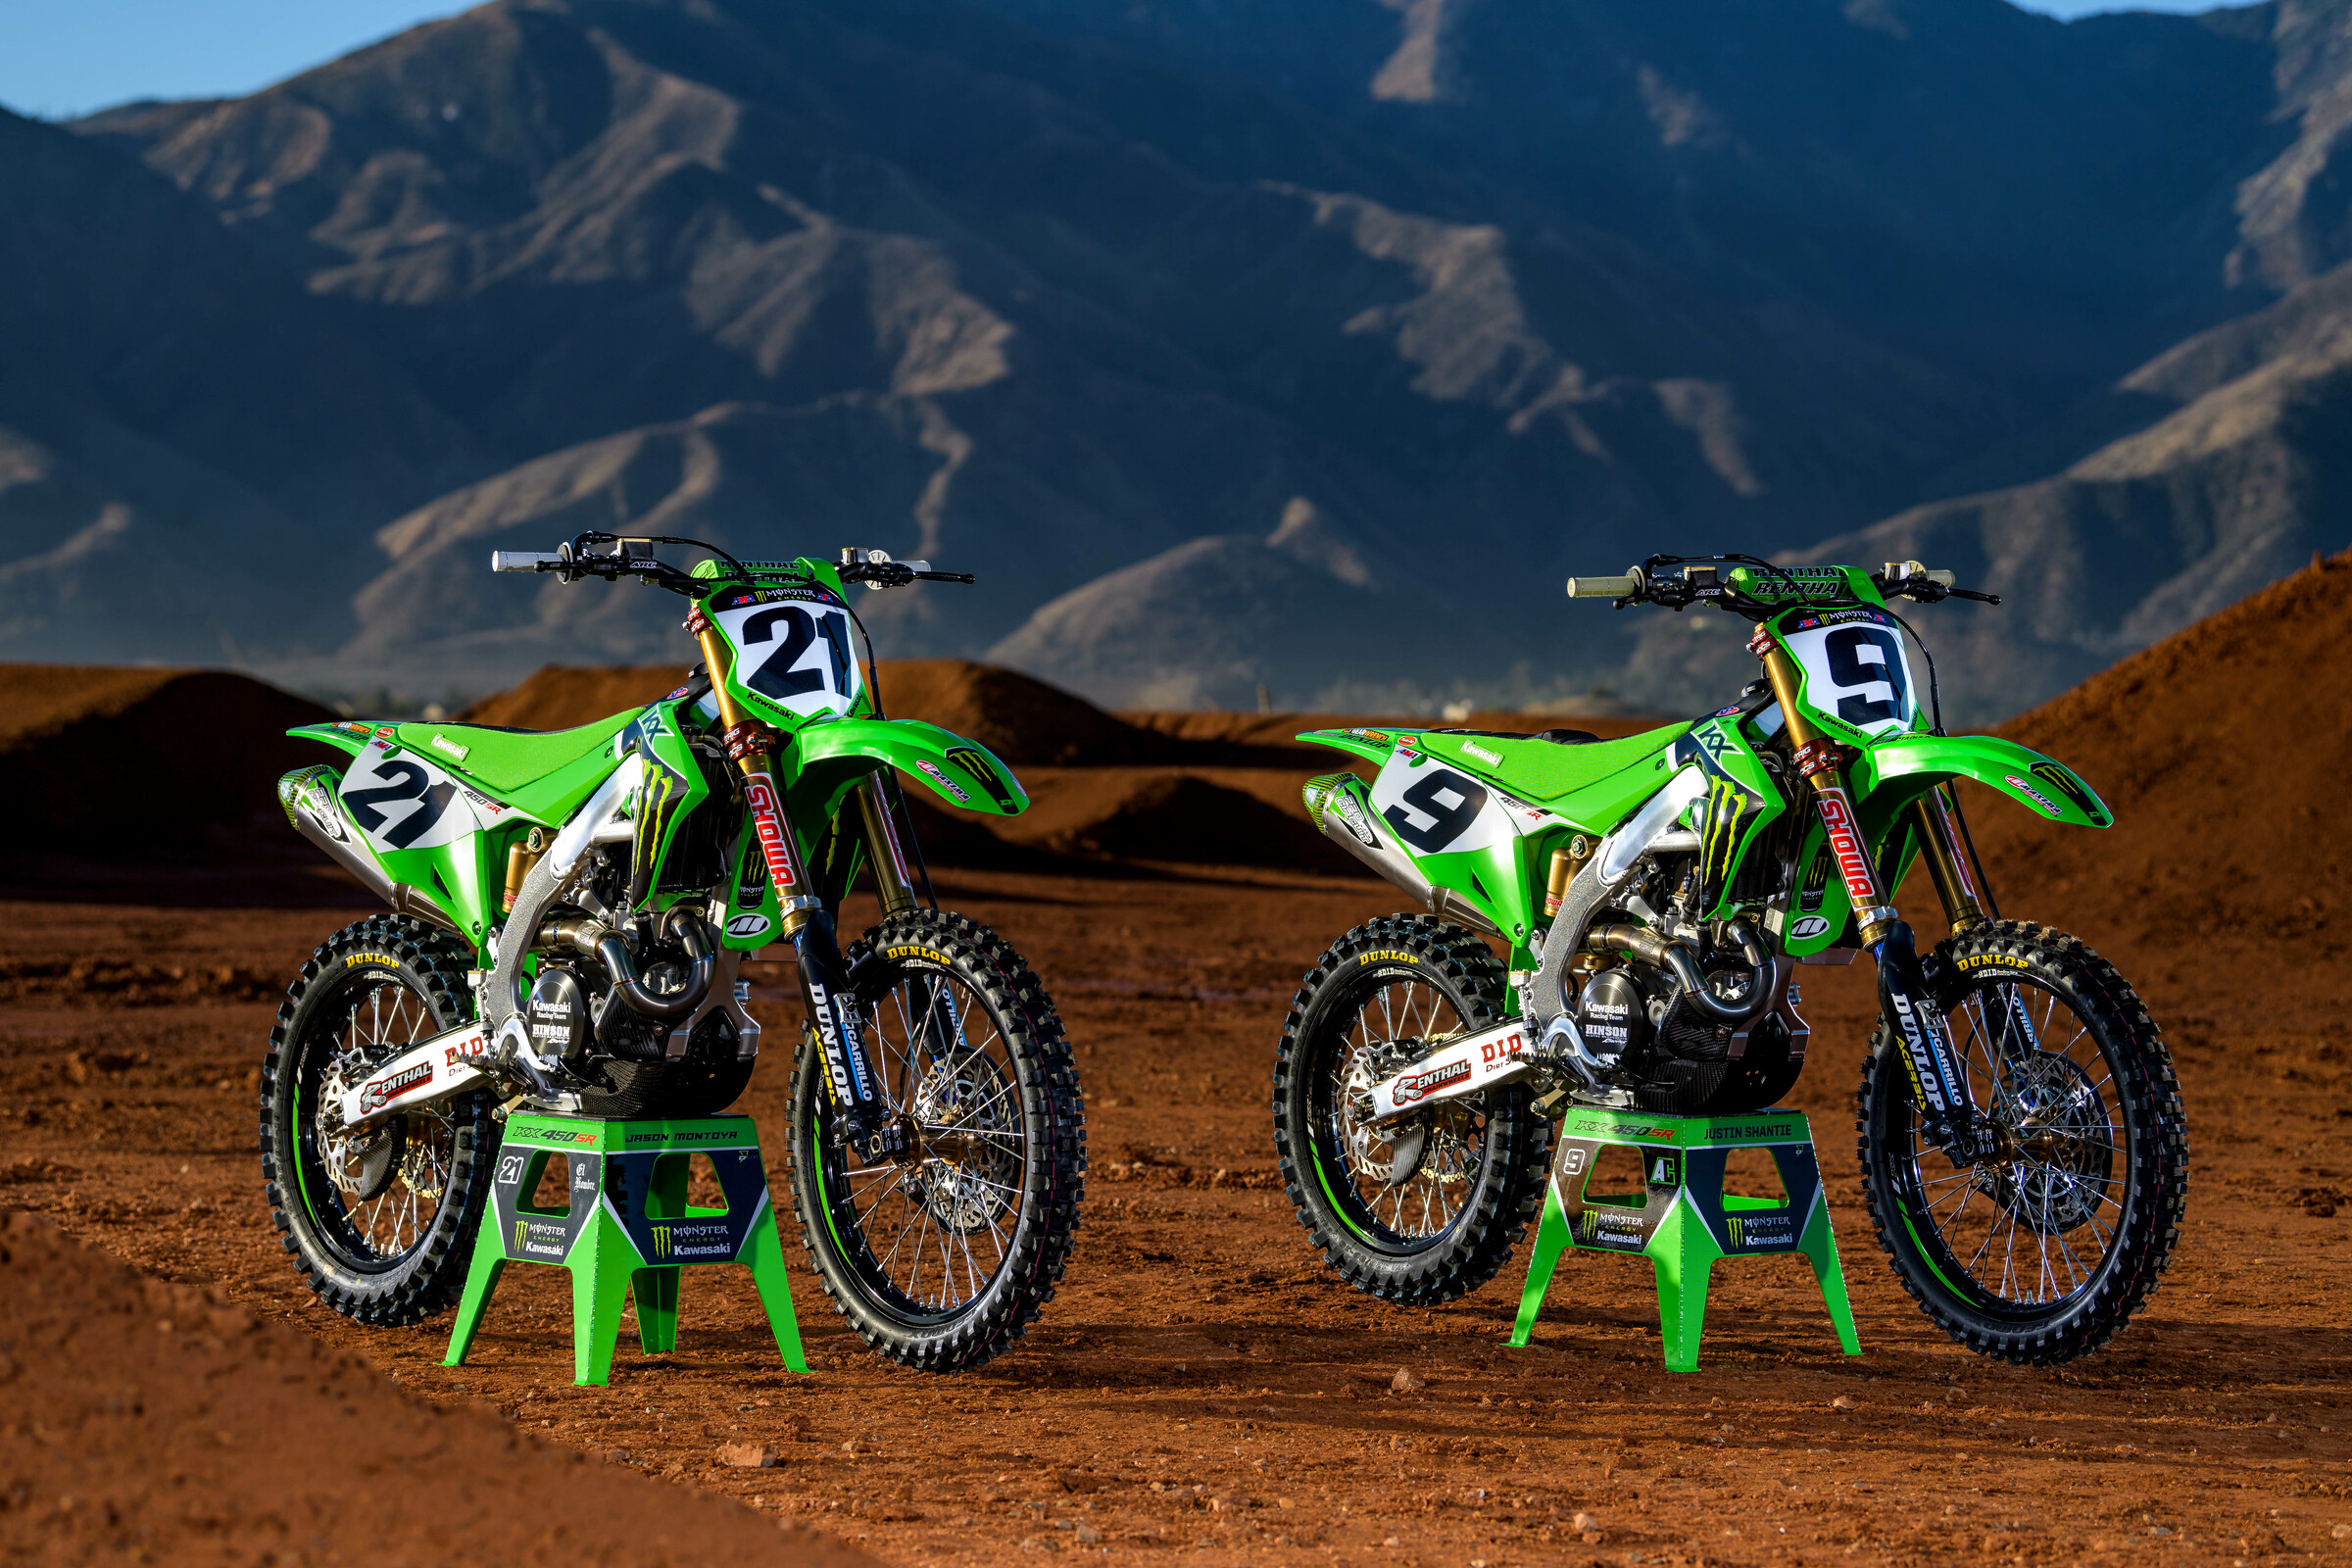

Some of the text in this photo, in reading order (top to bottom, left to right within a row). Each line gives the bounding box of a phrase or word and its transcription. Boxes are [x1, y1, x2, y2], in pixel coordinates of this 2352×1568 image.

[732, 594, 756, 606] AMA
[765, 587, 815, 597] MONSTER
[1798, 617, 1820, 628] AMA
[1830, 610, 1873, 621] MONSTER
[742, 606, 852, 700] 21
[1825, 626, 1910, 726] 9
[747, 691, 795, 720] Kawasaki
[1817, 710, 1864, 739] Kawasaki
[431, 734, 467, 759] Kawasaki
[1460, 741, 1501, 767] Kawasaki
[341, 760, 457, 849] 21
[464, 790, 501, 814] 450SR
[1383, 769, 1488, 854] 9
[1499, 797, 1542, 820] 450SR
[744, 784, 797, 888] SHOWA
[1817, 799, 1875, 899] SHOWA
[346, 953, 400, 968] DUNLOP
[887, 946, 951, 965] DUNLOP
[1359, 950, 1419, 965] DUNLOP
[1957, 955, 2029, 971] DUNLOP
[532, 1000, 571, 1013] Kawasaki
[1585, 1002, 1629, 1014] Kawasaki
[532, 1024, 570, 1037] HINSON
[1586, 1024, 1628, 1038] HINSON
[808, 983, 854, 1106] DUNLOP
[1891, 993, 1945, 1111] DUNLOP
[847, 1030, 873, 1102] CARRILLO
[1934, 1038, 1963, 1106] CARRILLO
[1424, 1073, 1469, 1094] CHAINWHEELS
[513, 1127, 597, 1147] KX 450SR
[625, 1131, 738, 1143] JASON MONTOYA
[1575, 1120, 1675, 1141] KX 450SR
[1703, 1124, 1791, 1140] JUSTIN SHANTIE
[498, 1156, 524, 1184] 21
[1564, 1149, 1585, 1175] 9
[1650, 1156, 1675, 1185] AC
[1599, 1212, 1643, 1227] MONSTER
[1744, 1216, 1790, 1227] MONSTER
[529, 1223, 566, 1237] MONSTER
[673, 1225, 729, 1237] MONSTER
[1596, 1230, 1642, 1245] Kawasaki
[1745, 1233, 1793, 1246] Kawasaki
[525, 1241, 564, 1255] Kawasaki
[674, 1243, 731, 1255] Kawasaki
